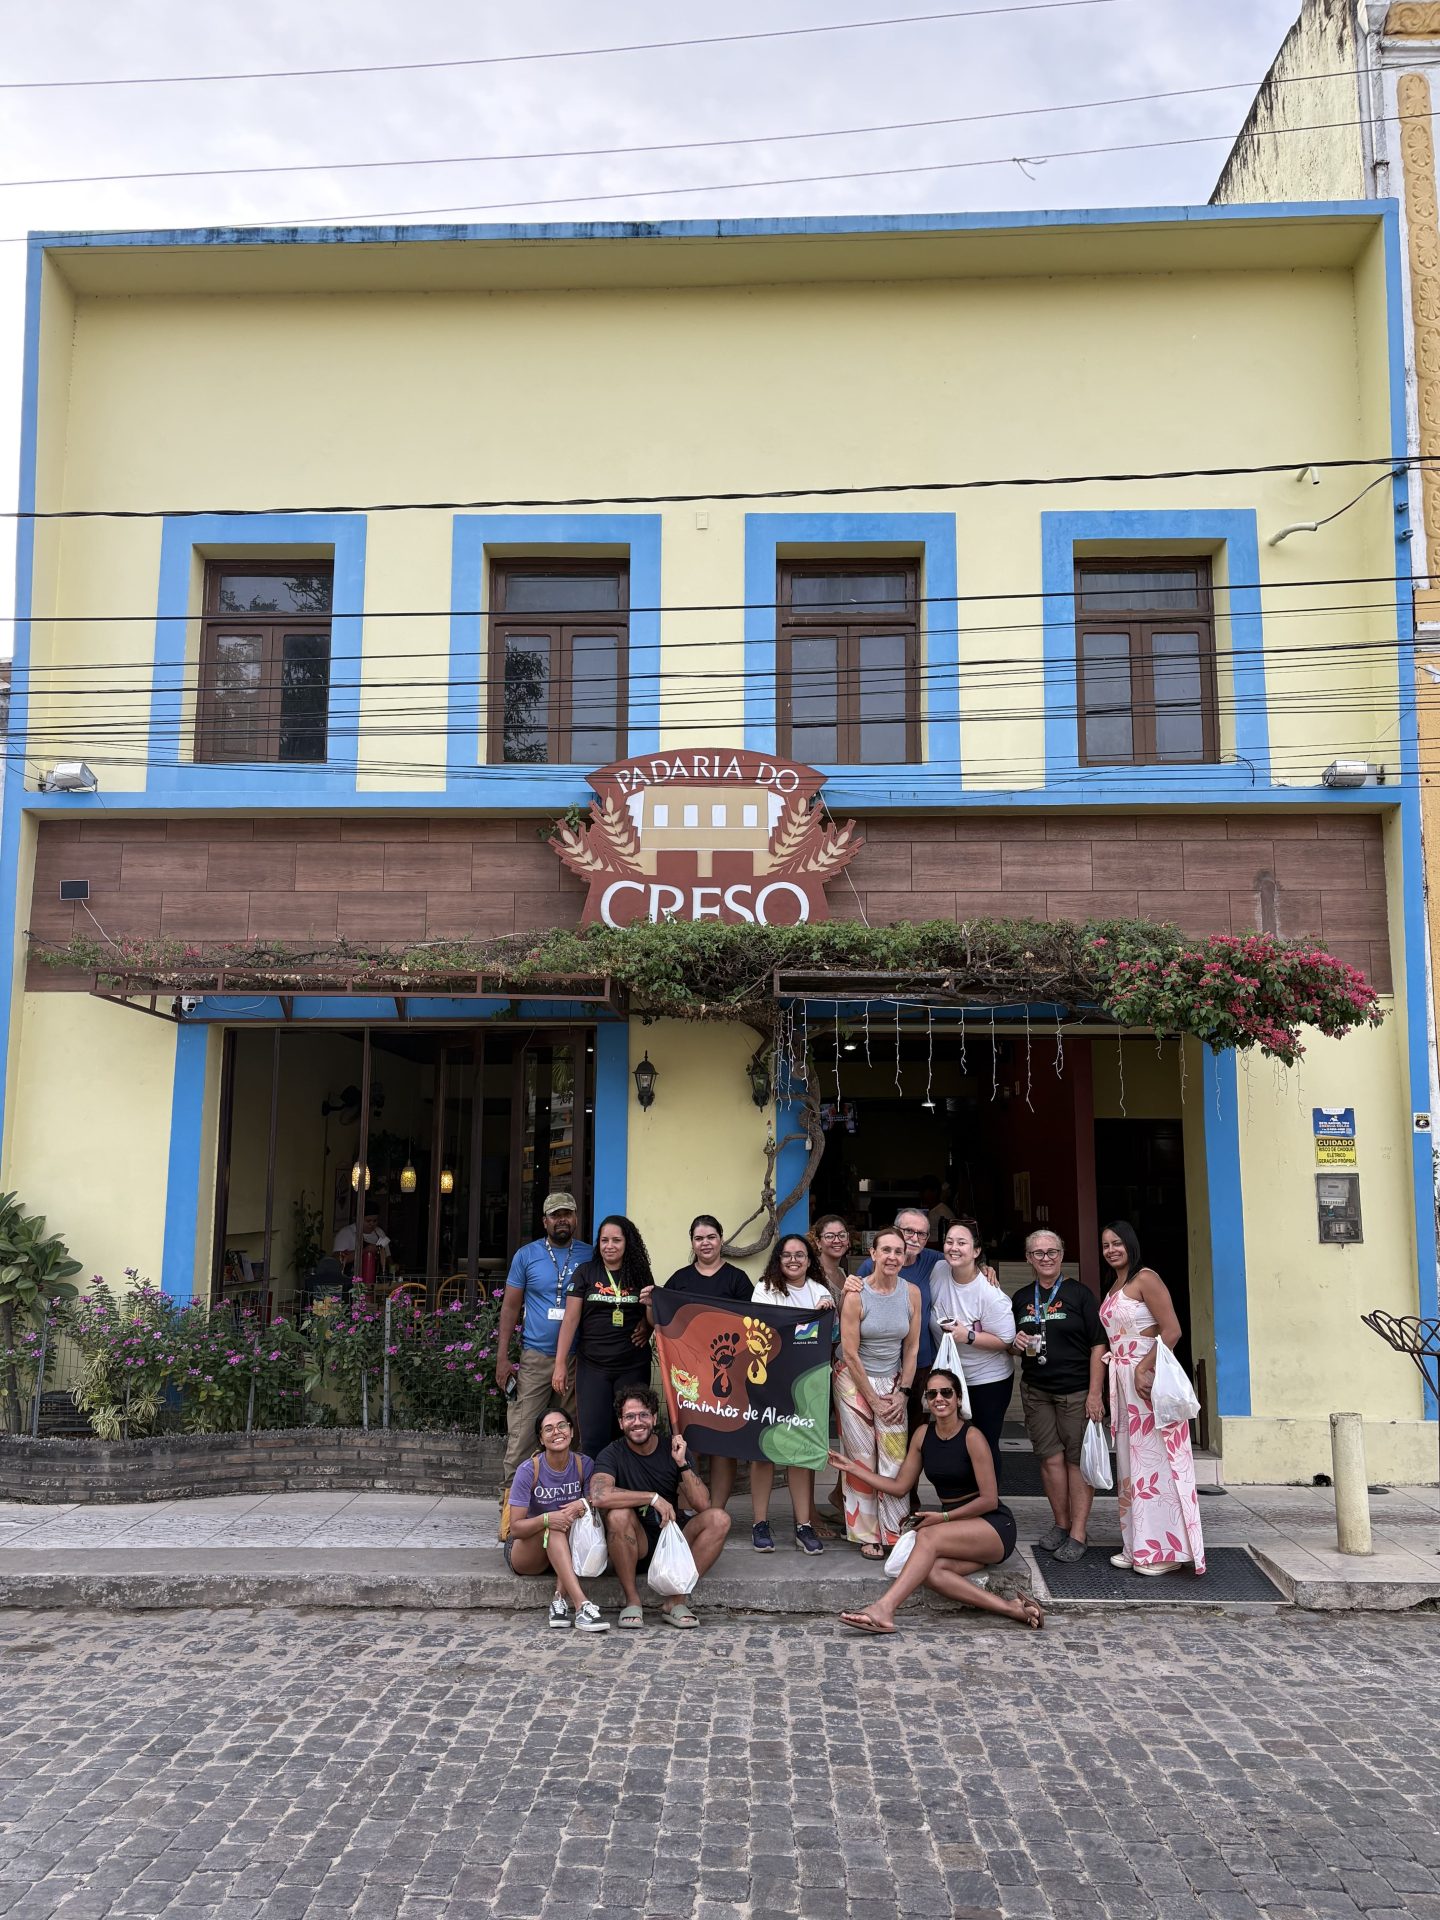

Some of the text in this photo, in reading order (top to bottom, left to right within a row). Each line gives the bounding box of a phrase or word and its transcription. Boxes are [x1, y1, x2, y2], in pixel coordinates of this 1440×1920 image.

[615, 755, 800, 795] PADARIA DO
[600, 880, 810, 930] CRESO
[676, 1391, 816, 1430] Caminhos de Alagoas
[534, 1481, 582, 1499] OXENTE
